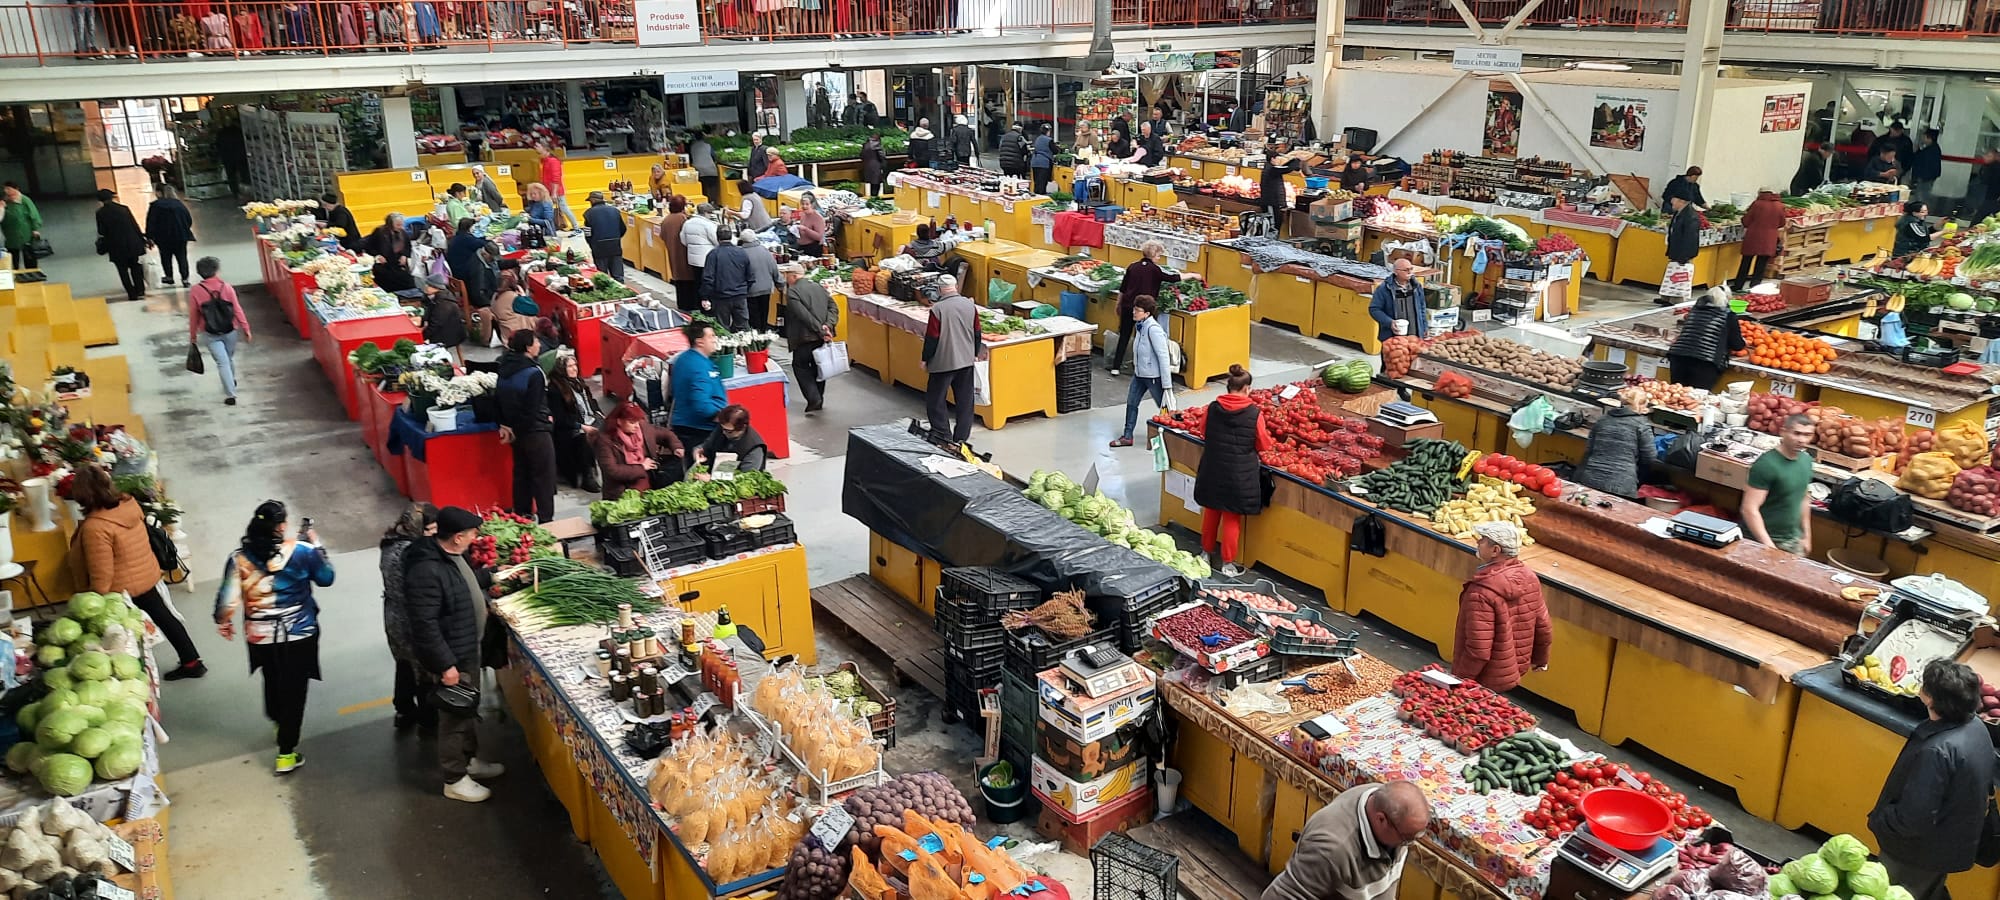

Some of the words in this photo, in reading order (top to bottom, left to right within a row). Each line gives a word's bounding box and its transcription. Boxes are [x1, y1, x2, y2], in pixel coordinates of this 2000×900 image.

[649, 13, 685, 21] Produse
[646, 23, 690, 31] Industriale
[1772, 381, 1793, 394] 271
[1908, 410, 1933, 424] 270
[1108, 696, 1134, 718] BONITA
